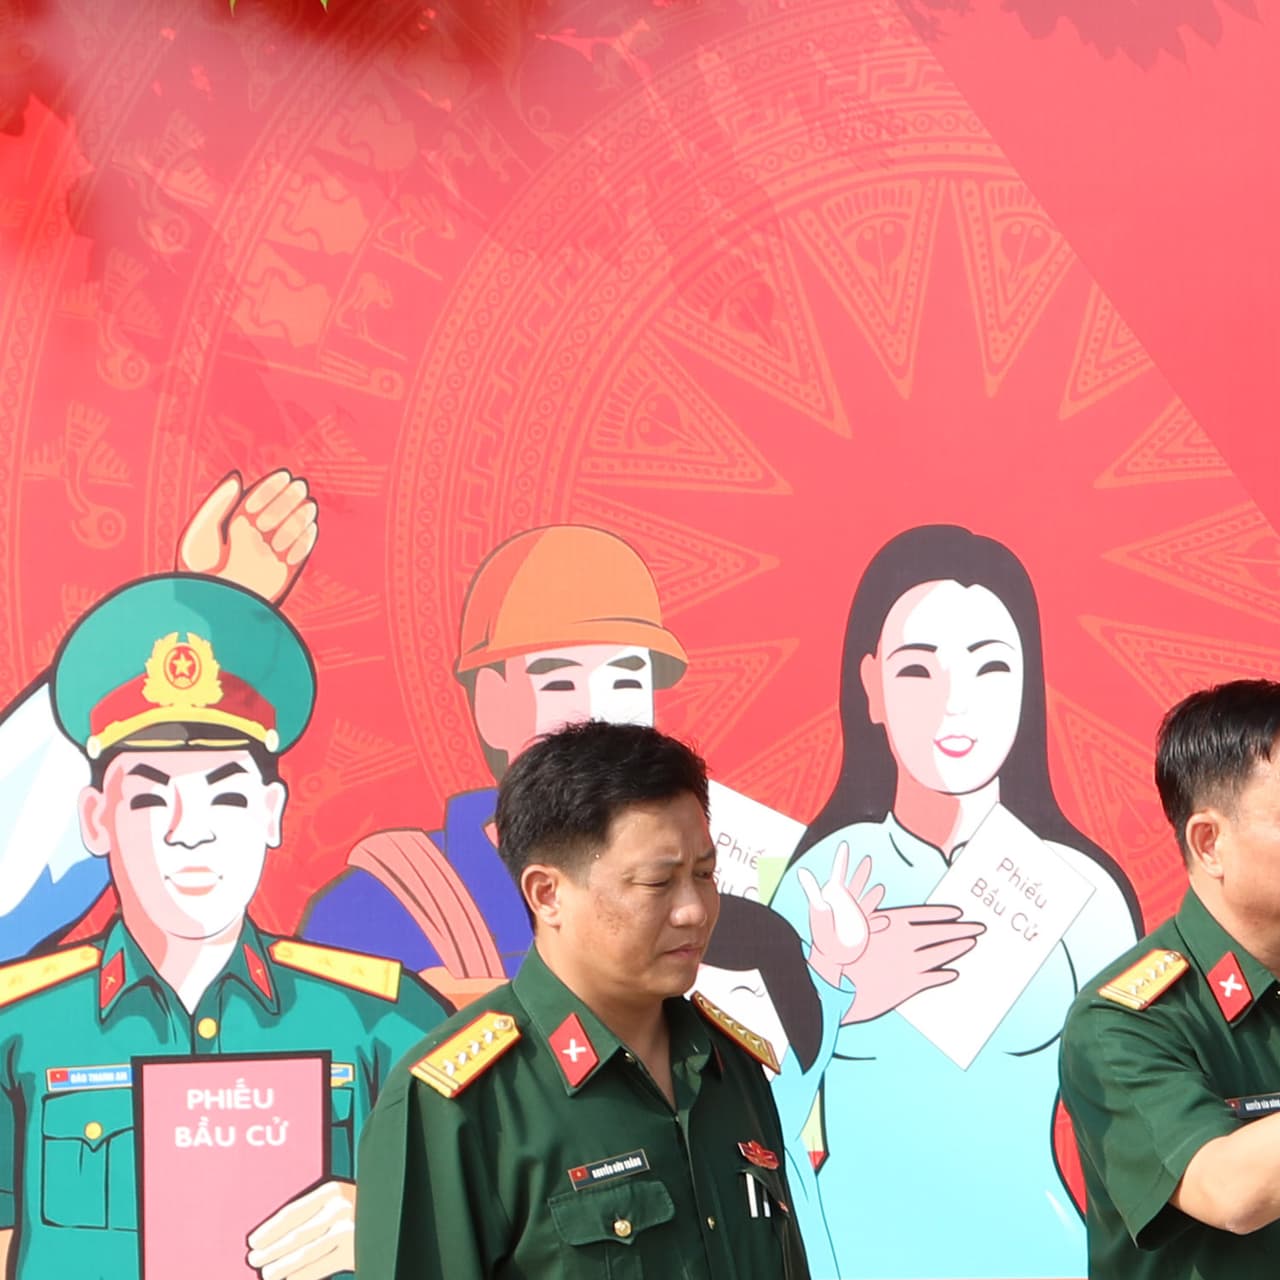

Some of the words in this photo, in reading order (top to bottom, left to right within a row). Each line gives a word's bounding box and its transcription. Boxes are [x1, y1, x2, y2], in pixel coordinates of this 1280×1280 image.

[996, 857, 1047, 909] Phiếu
[186, 1077, 274, 1110] PHIẾU
[174, 1115, 236, 1147] BẦU
[245, 1115, 289, 1147] CỬ
